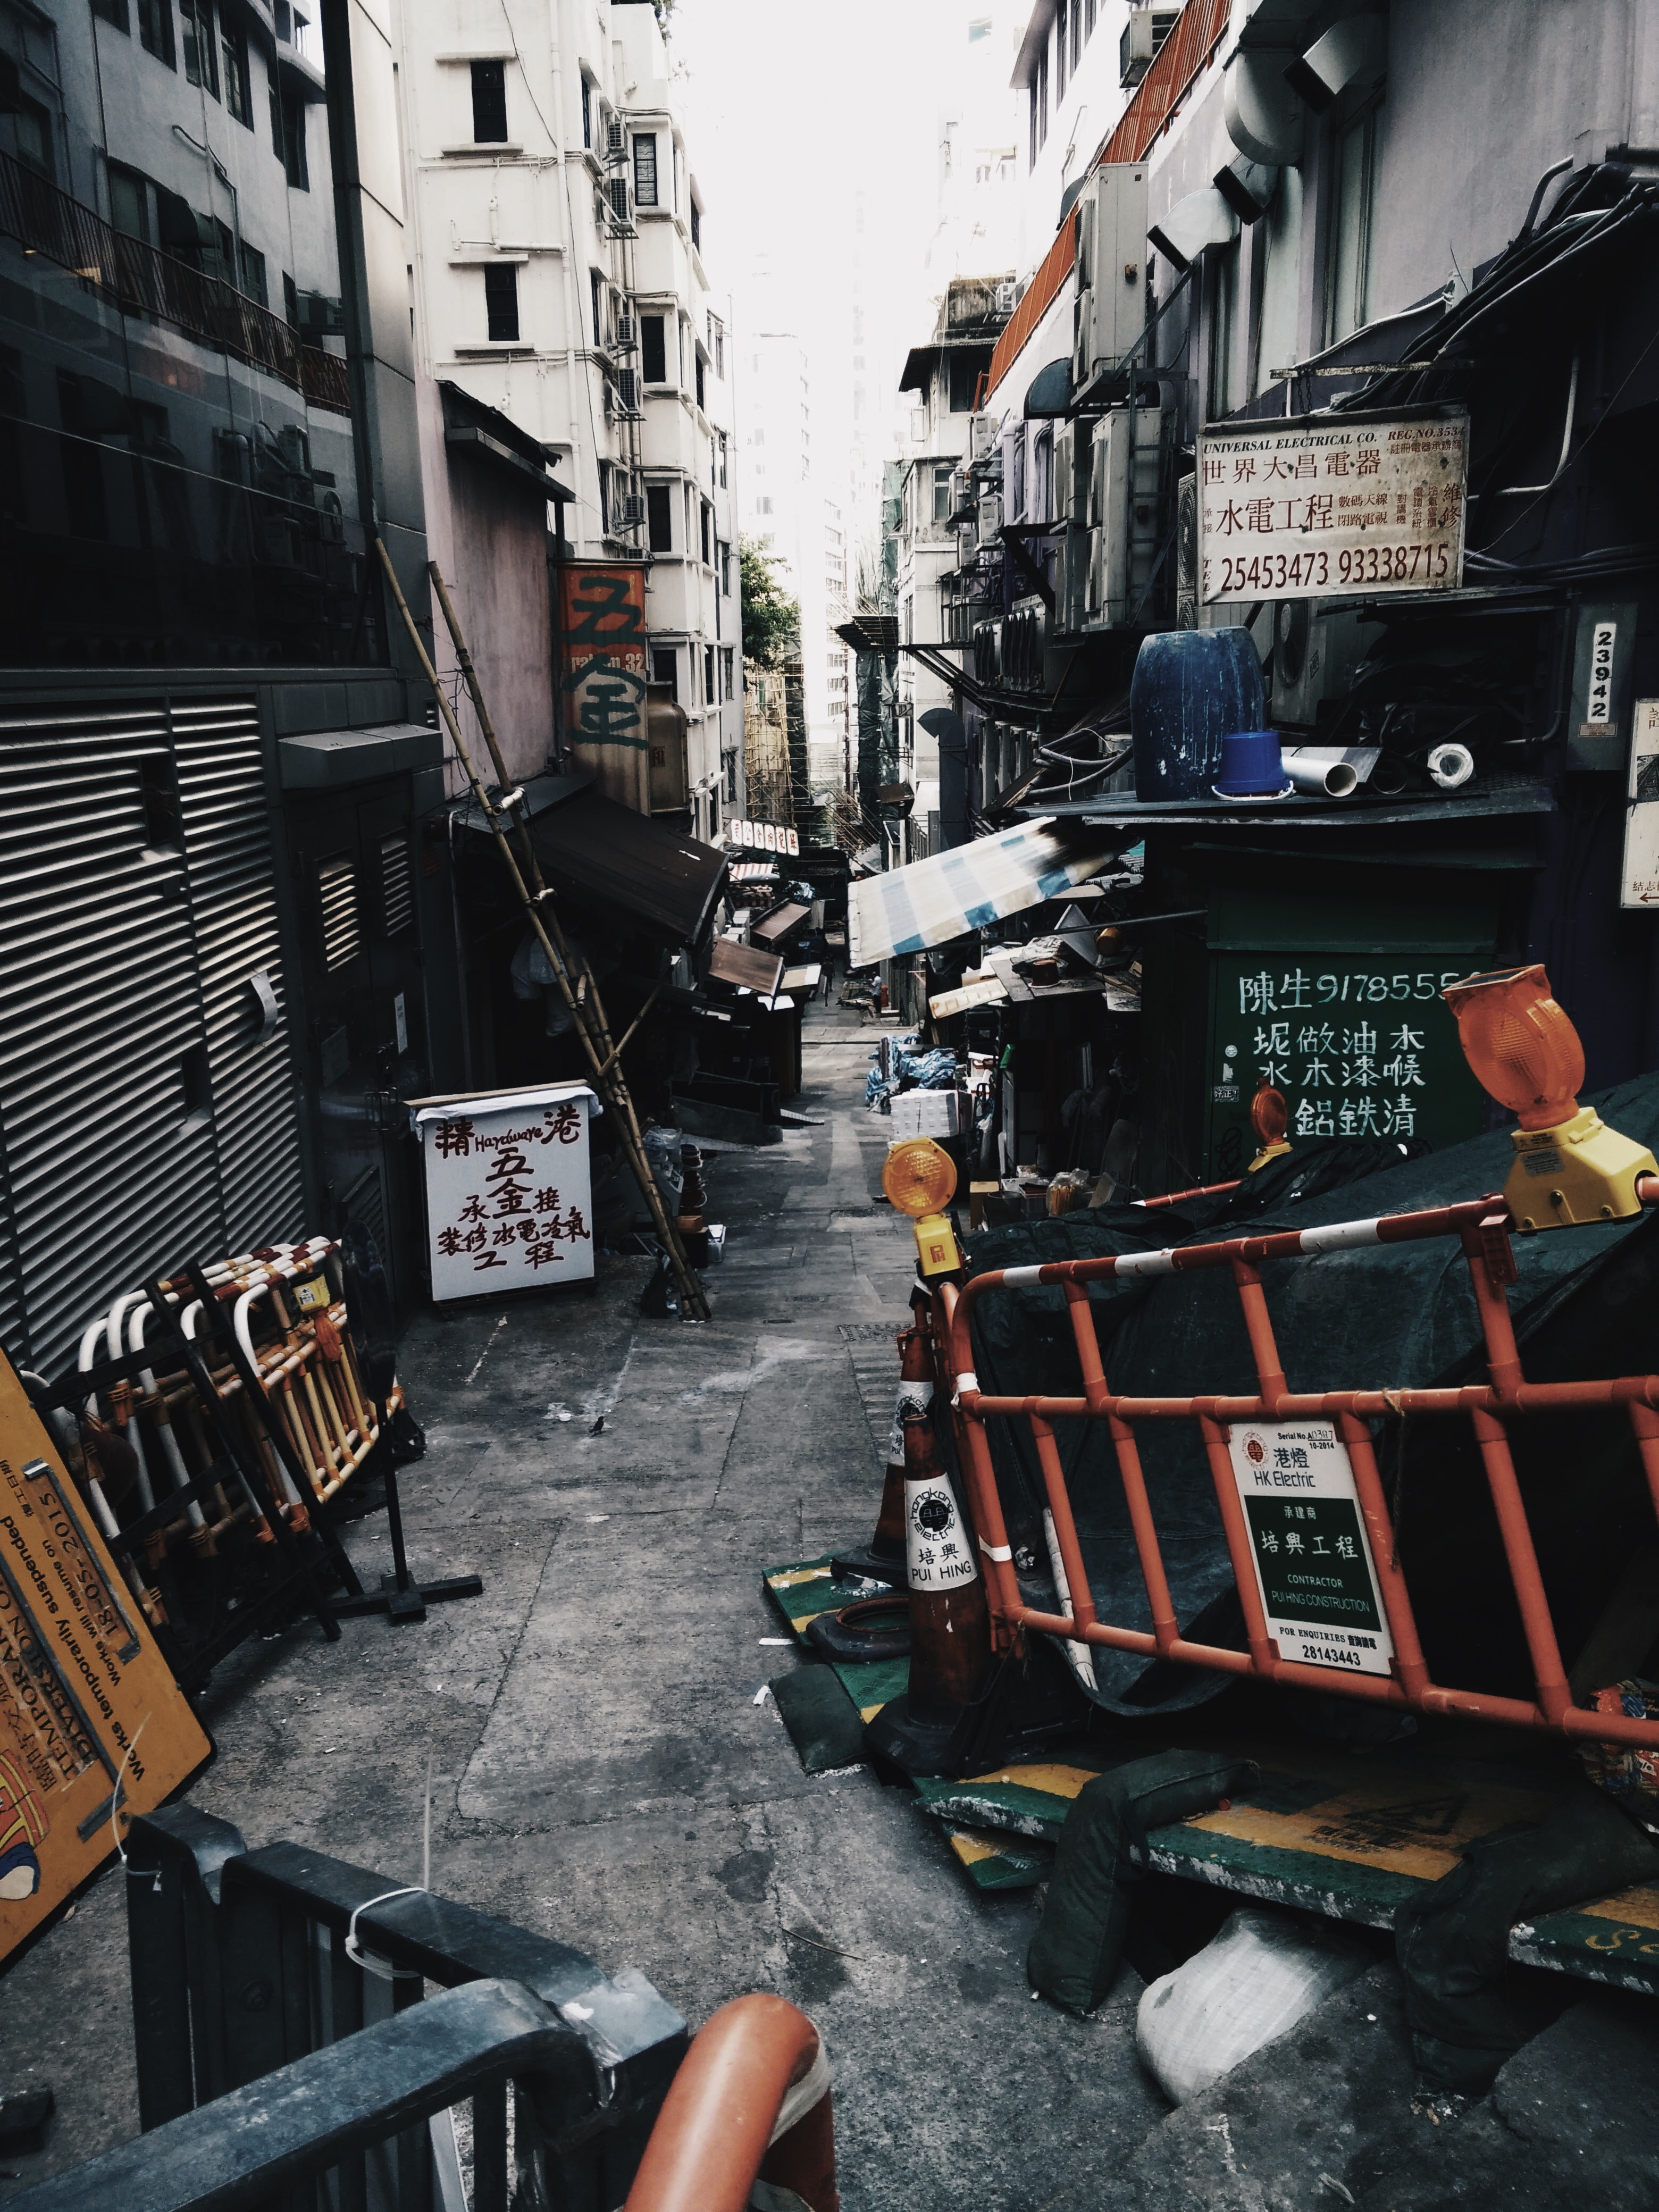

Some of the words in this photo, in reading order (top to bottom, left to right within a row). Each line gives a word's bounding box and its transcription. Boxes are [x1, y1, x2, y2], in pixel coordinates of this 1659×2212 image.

[1204, 440, 1272, 454] UNIVERSAL
[1276, 433, 1353, 449] ELECTRICAL
[1356, 432, 1377, 443] CO.
[1203, 449, 1381, 486] 世界大昌電器
[1339, 493, 1387, 508] 數碼天線
[1396, 493, 1407, 524] 對講機
[1442, 482, 1462, 528] 維修
[1216, 493, 1334, 536] 水電工程
[1338, 512, 1387, 526] 閉路電視
[1221, 551, 1328, 591] 25453473
[1339, 544, 1448, 583] 93338715
[1591, 631, 1612, 717] 23942
[485, 1146, 535, 1219] 五金
[1273, 1447, 1310, 1469] 港燈
[1254, 1470, 1272, 1486] HK
[1272, 1471, 1316, 1488] Electric
[1284, 1505, 1317, 1520] 承建商
[41, 1539, 56, 1559] on
[918, 1543, 960, 1565] 培興
[1261, 1530, 1359, 1560] 培興工程
[0, 1515, 59, 1614] suspended
[911, 1568, 931, 1581] PUI
[939, 1560, 972, 1579] HING
[53, 1561, 85, 1613] resume
[1287, 1574, 1344, 1588] CONTRACTOR
[1271, 1590, 1285, 1603] PUI
[1286, 1593, 1305, 1605] HING
[1306, 1594, 1370, 1613] CONSTRUCTION
[79, 1614, 97, 1639] will
[1279, 1627, 1295, 1636] FOR
[1298, 1629, 1346, 1643] ENQUIRIES
[95, 1640, 121, 1687] Works
[1302, 1644, 1361, 1666] 28143443
[55, 1619, 114, 1720] temporarily
[112, 1721, 146, 1782] Works
